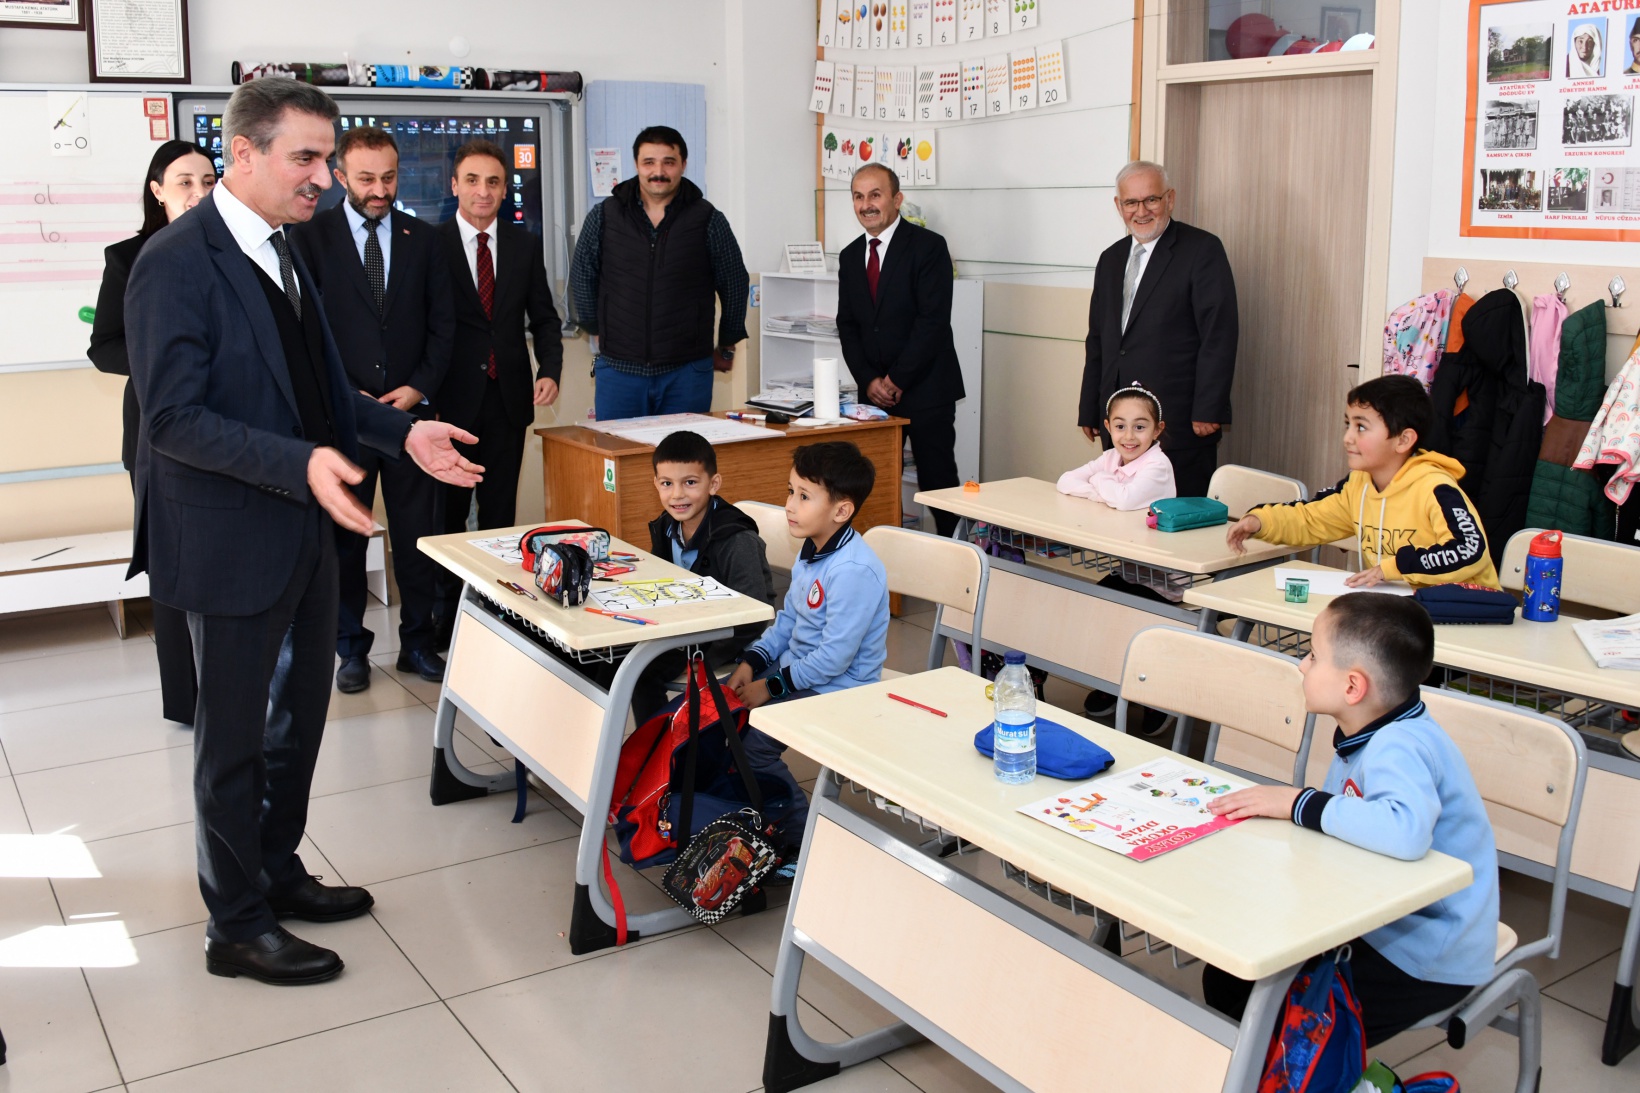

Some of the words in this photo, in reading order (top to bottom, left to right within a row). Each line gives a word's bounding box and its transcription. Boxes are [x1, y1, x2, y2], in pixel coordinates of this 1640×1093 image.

[1022, 16, 1028, 26] 9
[969, 26, 974, 38] 7
[994, 22, 998, 34] 8
[824, 34, 830, 45] 0
[841, 36, 844, 46] 1
[856, 36, 862, 48] 2
[876, 36, 881, 48] 3
[895, 36, 900, 46] 4
[917, 34, 922, 45] 5
[941, 32, 946, 42] 6
[1020, 95, 1028, 107] 19
[1045, 89, 1058, 103] 20
[816, 100, 823, 110] 10
[840, 104, 845, 114] 11
[970, 104, 978, 115] 17
[992, 100, 1000, 112] 18
[860, 106, 867, 117] 12
[880, 108, 886, 118] 13
[898, 108, 906, 118] 14
[922, 108, 930, 118] 15
[945, 107, 952, 118] 16
[518, 152, 532, 164] 30
[1420, 549, 1459, 570] CLUB
[998, 726, 1017, 738] Murat
[1115, 820, 1160, 840] DİZİSİ
[1126, 824, 1178, 846] OKUMA
[1148, 830, 1195, 853] KOLAY
